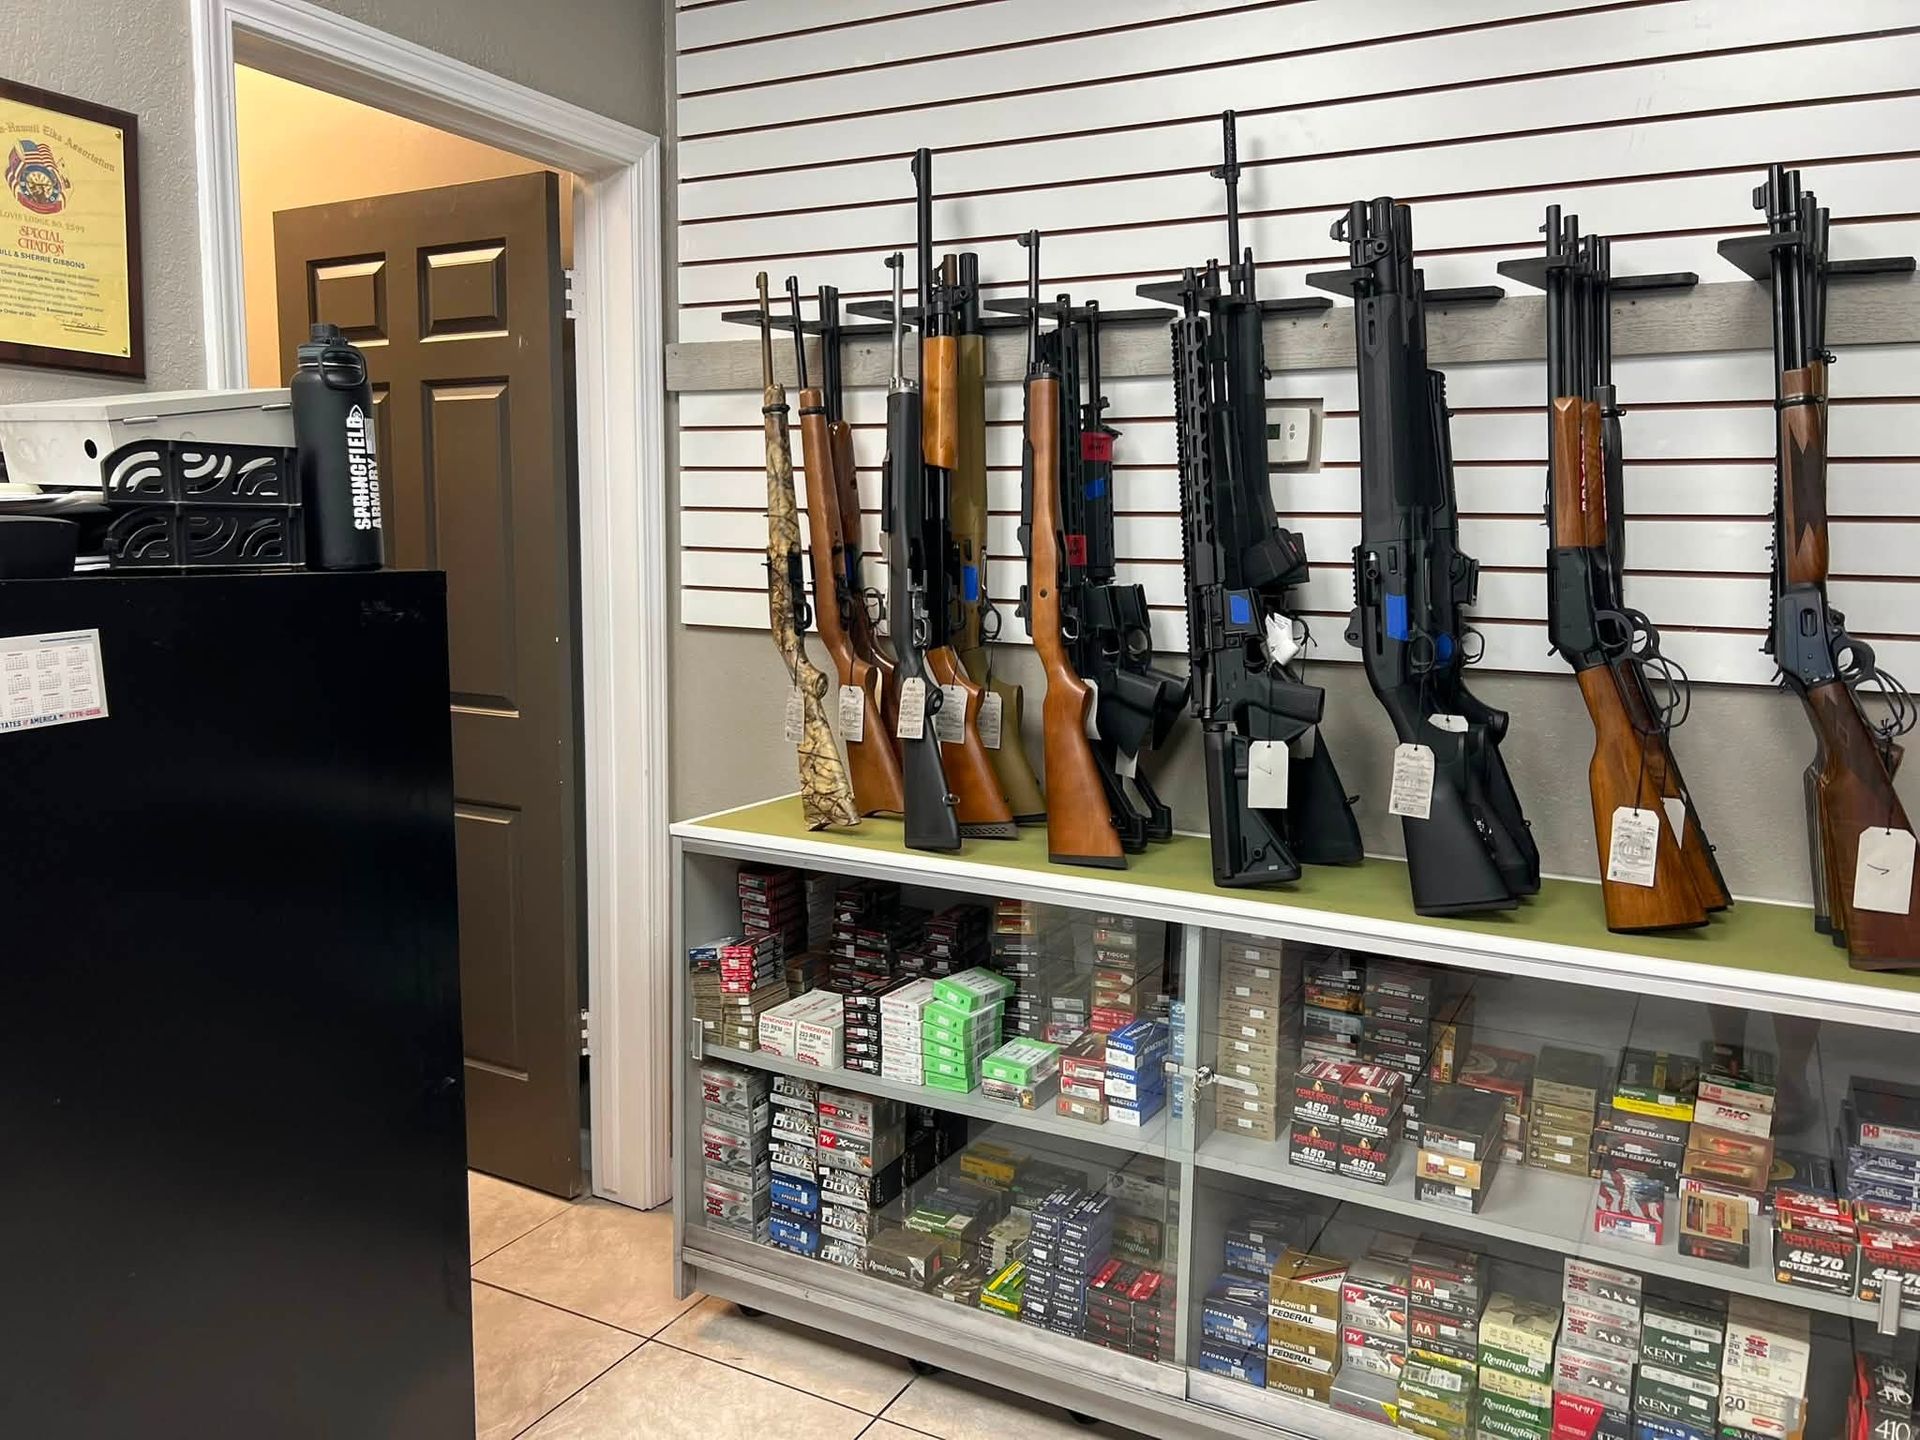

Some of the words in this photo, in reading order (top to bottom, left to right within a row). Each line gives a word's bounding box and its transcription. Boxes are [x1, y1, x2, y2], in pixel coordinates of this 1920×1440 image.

[21, 252, 51, 263] SHERRIE
[53, 257, 86, 270] GIBBONS
[346, 415, 372, 531] SPRINGFIELD
[368, 457, 383, 530] ARMORY
[30, 714, 58, 725] AMERICA
[1107, 1040, 1134, 1052] MAGTECH
[1107, 1070, 1135, 1081] MAGTECH
[1305, 1101, 1329, 1113] 450
[1716, 1107, 1751, 1121] PMC
[1353, 1113, 1377, 1125] 450
[1301, 1147, 1326, 1159] 450
[1351, 1158, 1375, 1170] 450
[772, 1178, 795, 1189] FEDERAL
[770, 1217, 794, 1227] FEDERAL
[869, 1259, 906, 1277] Remington
[1789, 1250, 1845, 1271] 45-70
[1780, 1260, 1851, 1281] GOVERNMENT
[1416, 1279, 1431, 1290] AA
[1205, 1308, 1235, 1321] FEDERAL
[1271, 1308, 1314, 1325] FEDERAL
[1416, 1323, 1431, 1336] AA
[1202, 1351, 1233, 1364] FEDERAL
[1272, 1348, 1313, 1365] FEDERAL
[1643, 1345, 1687, 1364] KENT
[1482, 1351, 1541, 1377] Remington
[1400, 1381, 1439, 1399] Remington
[1482, 1397, 1542, 1424] Remington
[1638, 1395, 1682, 1416] KENT
[1724, 1395, 1746, 1411] 20
[1400, 1410, 1438, 1427] Remington
[1638, 1419, 1675, 1434] FEDERAL
[1481, 1415, 1541, 1440] Remington
[1874, 1418, 1911, 1440] 410
